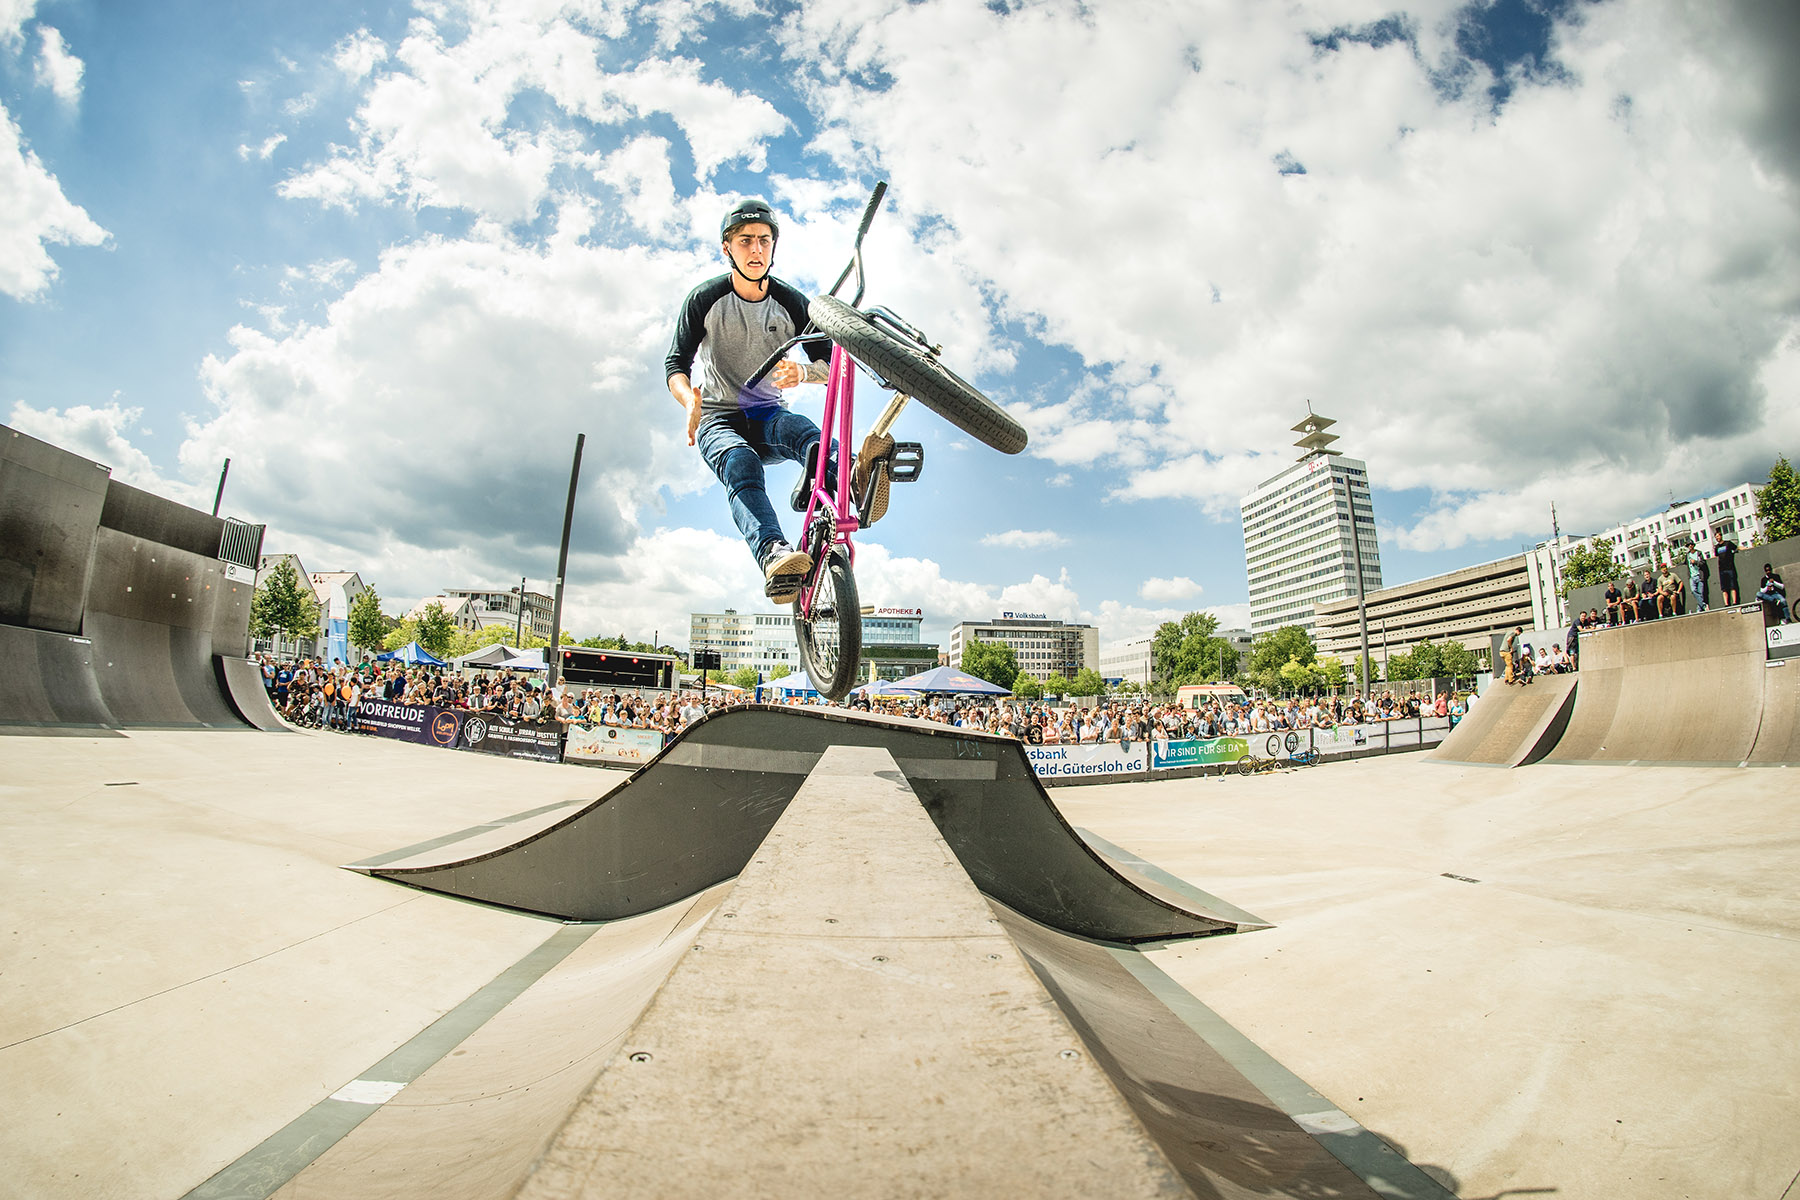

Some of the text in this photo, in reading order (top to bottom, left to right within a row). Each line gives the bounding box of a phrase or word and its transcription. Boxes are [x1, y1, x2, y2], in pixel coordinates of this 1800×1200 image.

[360, 701, 425, 723] VORFREUDE
[1177, 747, 1197, 756] SIND
[1216, 744, 1226, 754] SIE
[1227, 743, 1240, 753] DA
[1126, 760, 1142, 771] eG
